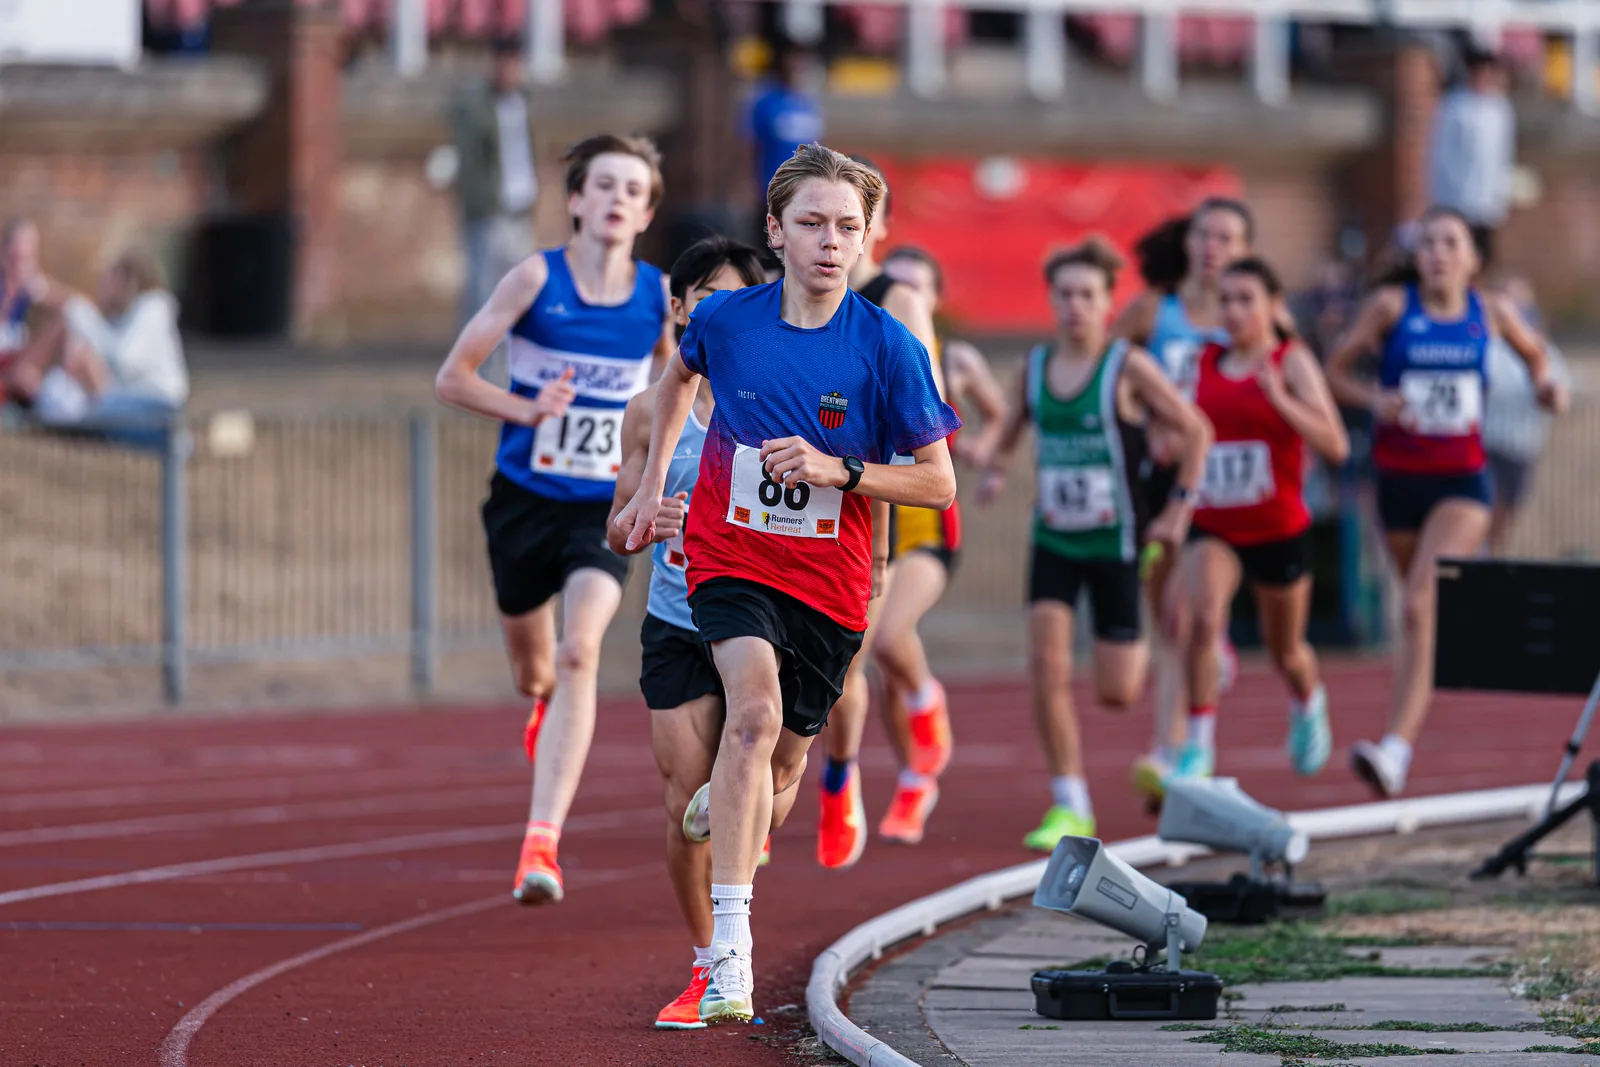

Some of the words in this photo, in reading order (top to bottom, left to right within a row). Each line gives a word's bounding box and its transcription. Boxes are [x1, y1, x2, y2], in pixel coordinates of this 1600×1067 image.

[820, 395, 849, 407] BRENTWOOD
[558, 414, 616, 455] 123
[758, 458, 811, 511] 86
[771, 514, 805, 525] Runners'
[769, 523, 802, 534] Retreat
